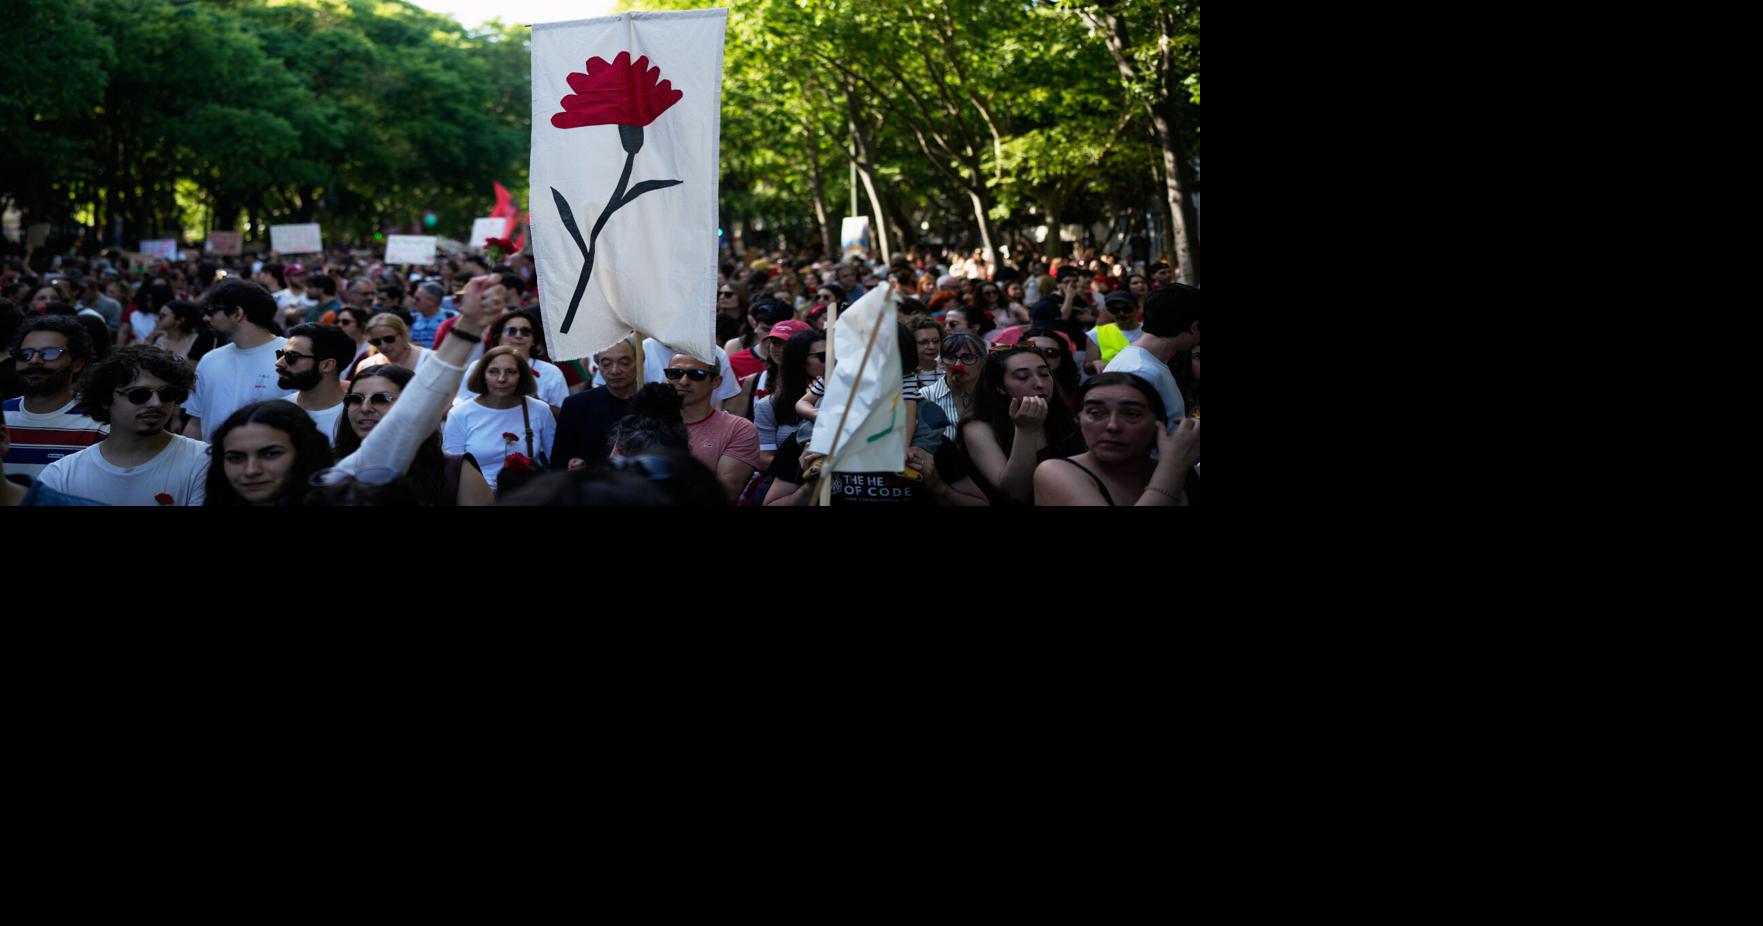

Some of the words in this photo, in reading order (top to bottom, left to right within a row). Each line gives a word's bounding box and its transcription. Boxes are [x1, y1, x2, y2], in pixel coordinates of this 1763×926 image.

[842, 474, 864, 485] THE
[844, 485, 862, 496] OF
[867, 486, 913, 497] CODE
